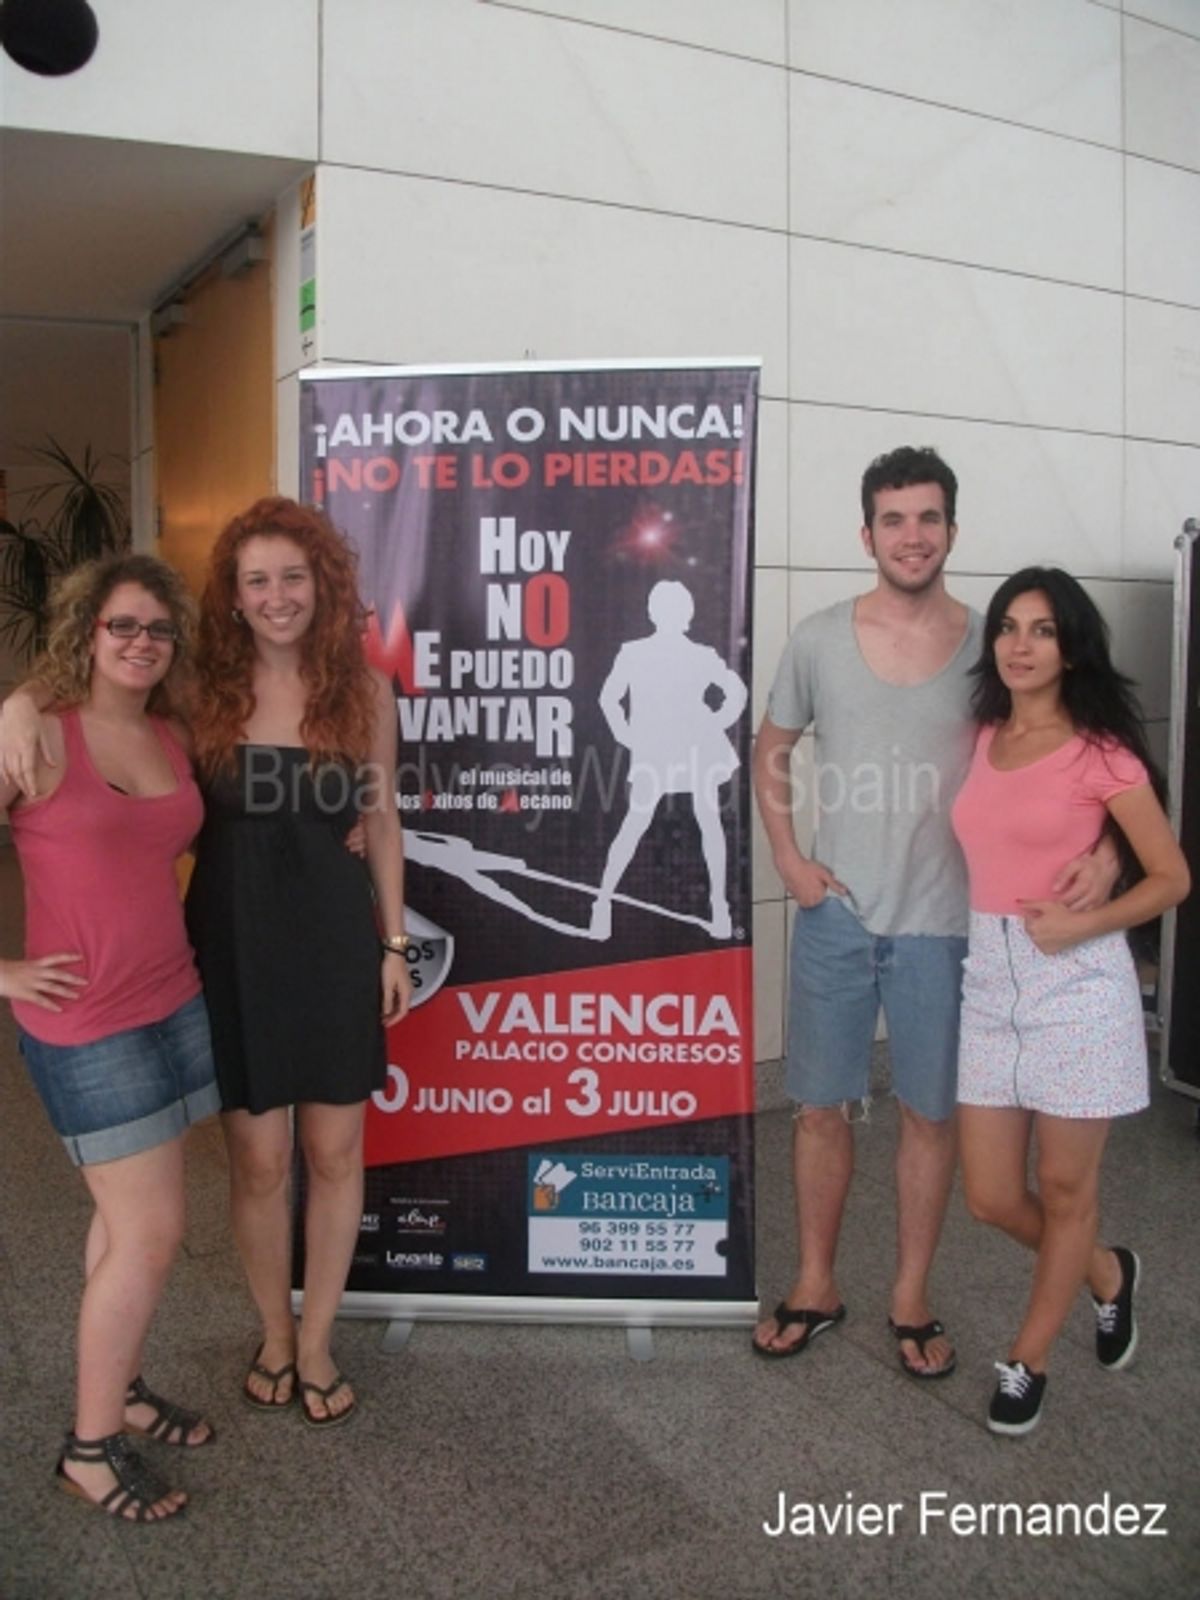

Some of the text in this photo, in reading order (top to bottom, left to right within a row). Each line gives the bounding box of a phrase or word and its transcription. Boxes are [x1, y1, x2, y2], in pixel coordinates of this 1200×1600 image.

[315, 404, 744, 457] ¡AHORA O NUNCA!
[413, 453, 457, 489] TE
[472, 452, 529, 488] LO
[544, 450, 743, 487] PIERDAS!
[487, 573, 570, 648] NO
[450, 649, 574, 690] PUEDO
[460, 768, 572, 787] el musical de
[477, 791, 497, 810] de
[457, 992, 740, 1036] VALENCIA
[456, 1040, 742, 1065] PALACIO CONGRESOS
[413, 1088, 513, 1115] JUNIO
[523, 1089, 550, 1115] al
[566, 1067, 601, 1118] 3
[608, 1091, 697, 1118] JULIO
[581, 1162, 717, 1180] ServiEntrada
[645, 1222, 667, 1236] 55
[674, 1223, 695, 1236] 77
[580, 1238, 695, 1252] 902 11 55 77
[542, 1256, 695, 1272] www.bancaja.es
